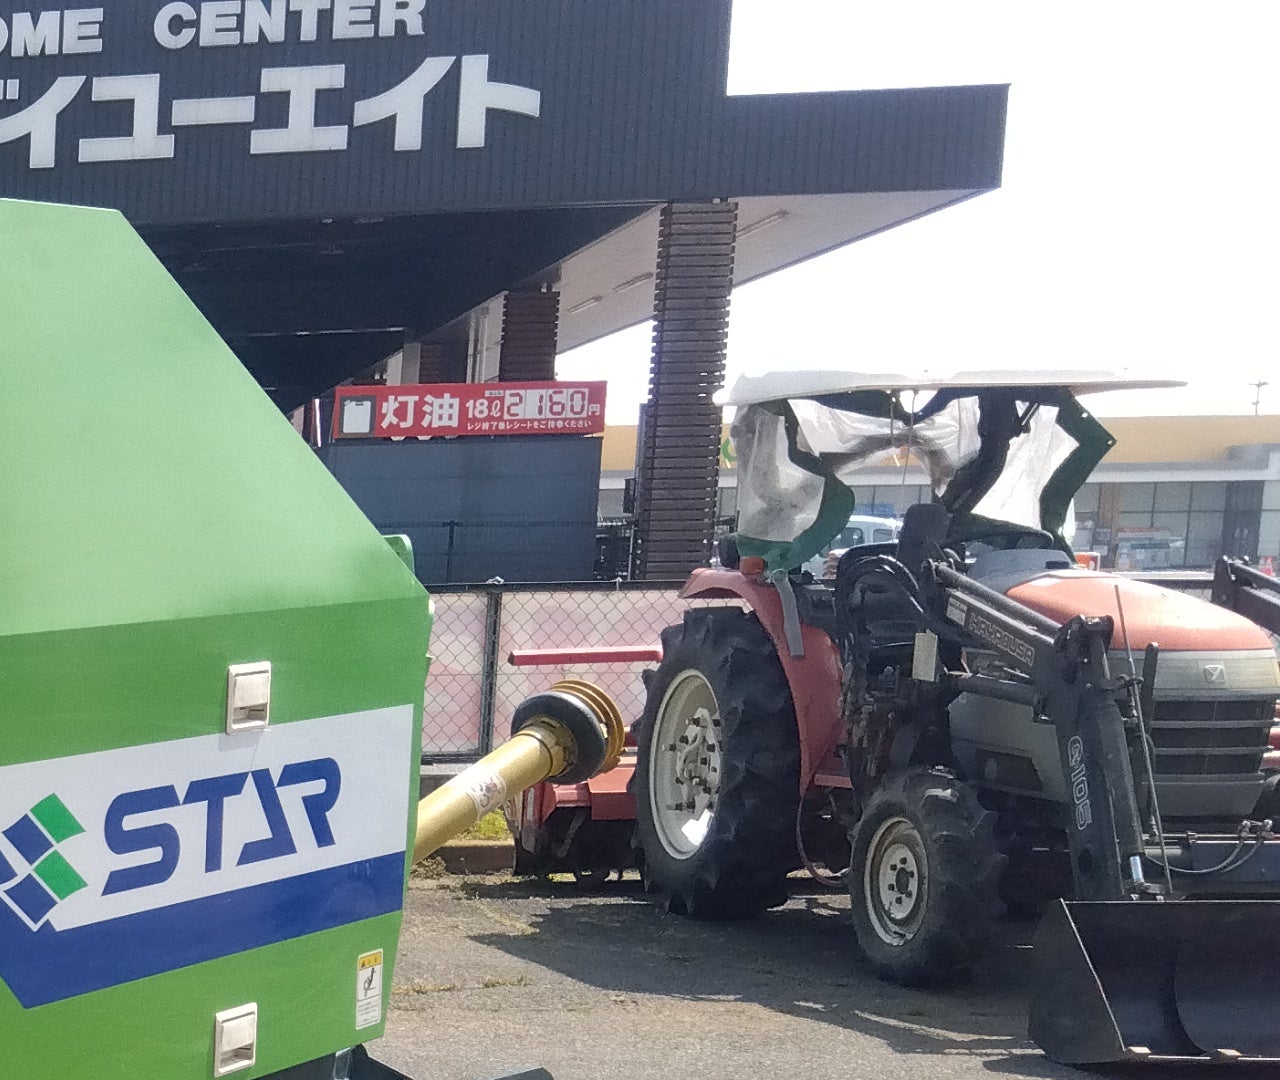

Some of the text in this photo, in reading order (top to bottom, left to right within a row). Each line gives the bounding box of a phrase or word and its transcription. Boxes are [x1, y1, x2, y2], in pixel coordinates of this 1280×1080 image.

[153, 0, 425, 49] CENTER
[381, 393, 460, 428] 灯油
[101, 757, 341, 896] STAR
